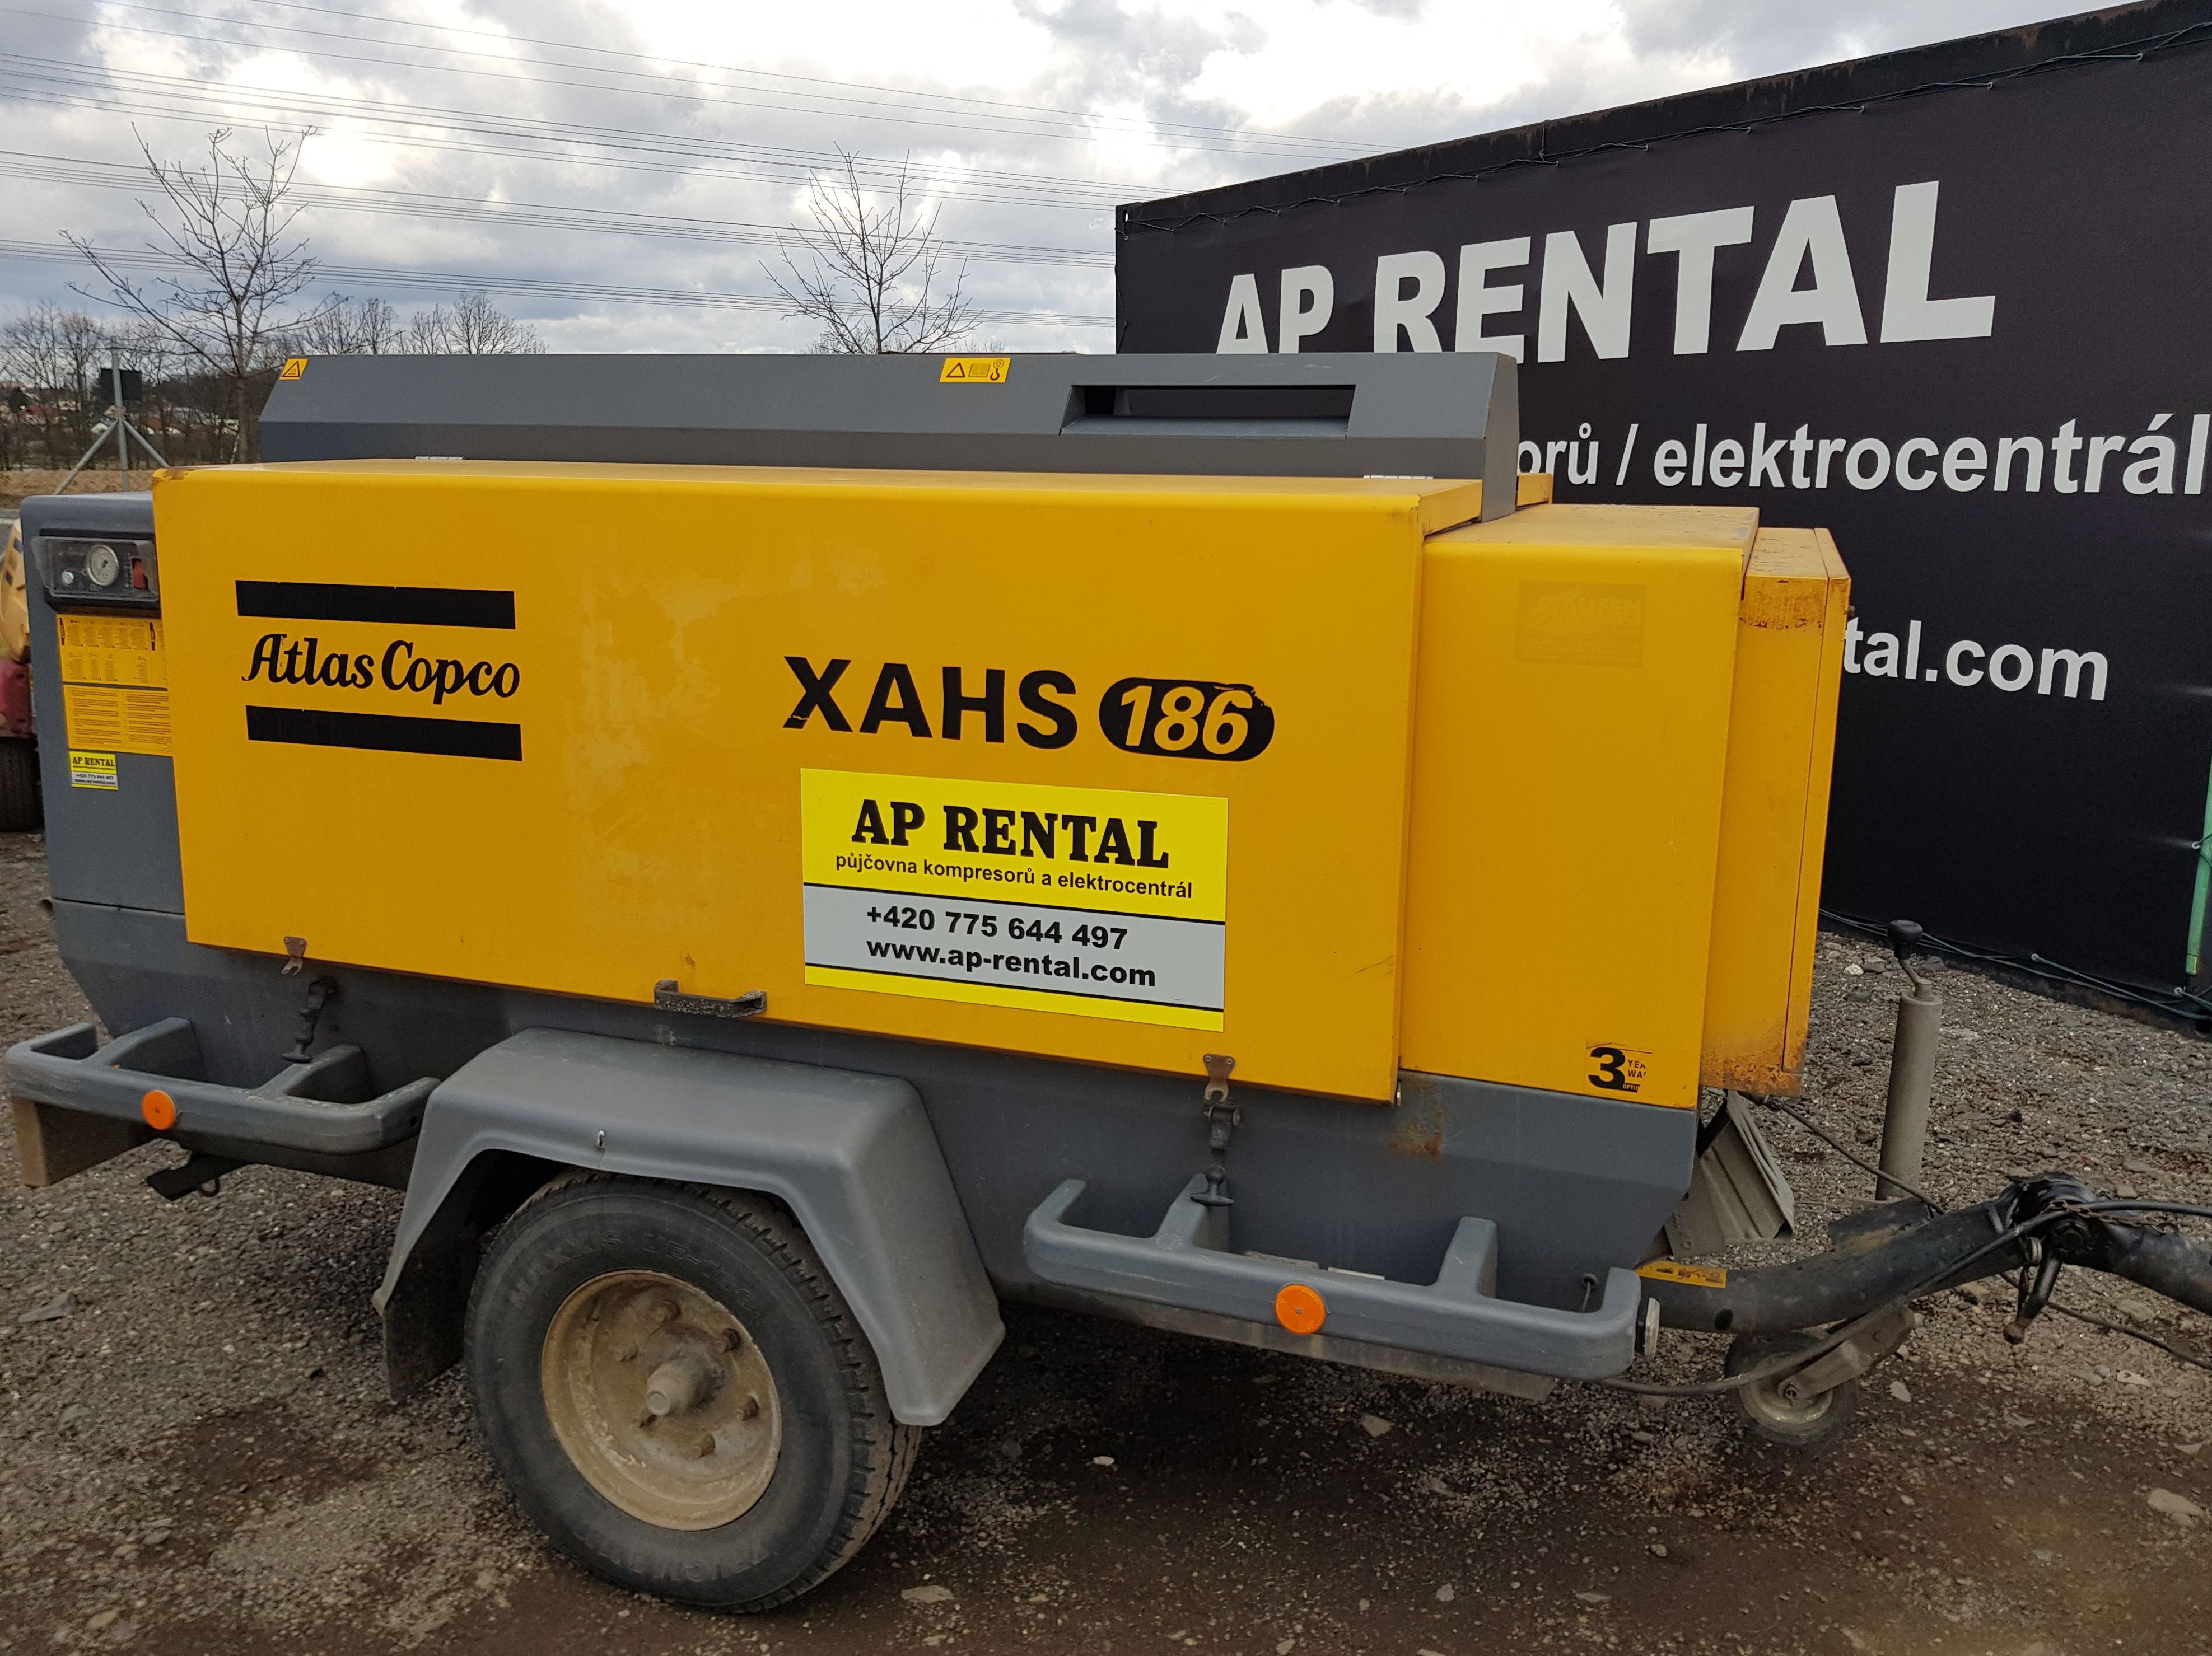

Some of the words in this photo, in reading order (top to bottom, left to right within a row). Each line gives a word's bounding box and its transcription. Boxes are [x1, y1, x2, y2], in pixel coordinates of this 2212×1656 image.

[1216, 265, 1334, 354] AP
[1374, 180, 1996, 364] RENTAL
[1654, 413, 2211, 495] elektrocentrál
[241, 633, 374, 689] Atlas
[381, 640, 520, 705] Copco
[782, 656, 1077, 749] XAHS
[1119, 685, 1253, 755] 186
[72, 756, 83, 765] AP
[85, 757, 115, 767] RENTAL
[851, 799, 925, 846] AP
[943, 805, 1169, 869] RENTAL
[836, 853, 917, 874] půjčovna
[923, 859, 1035, 886] kompresorů
[1042, 873, 1052, 886] a
[1058, 872, 1192, 899] elektrocentrál
[867, 905, 935, 931] +420
[945, 911, 998, 938] 775
[1008, 918, 1063, 944] 644
[1072, 924, 1128, 951] 497
[866, 941, 1156, 988] www.ap-rental.com
[1588, 1047, 1625, 1091] 3
